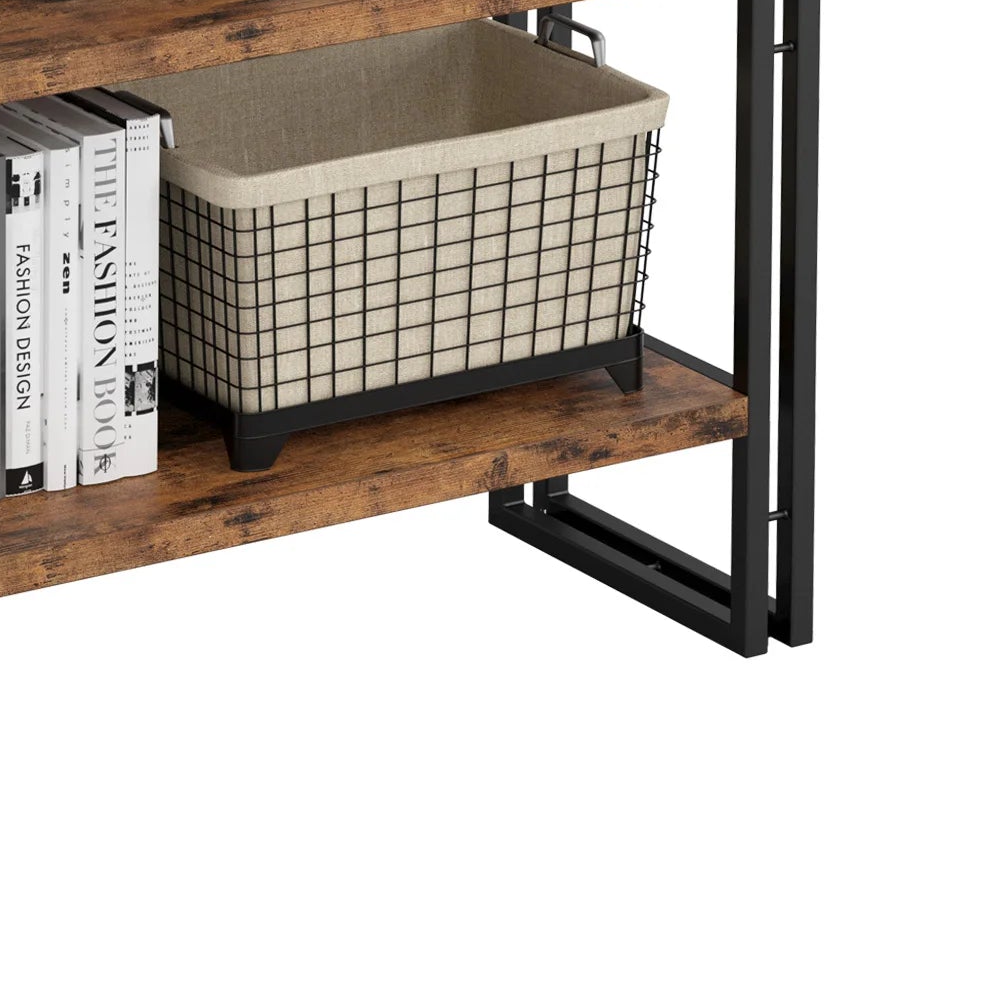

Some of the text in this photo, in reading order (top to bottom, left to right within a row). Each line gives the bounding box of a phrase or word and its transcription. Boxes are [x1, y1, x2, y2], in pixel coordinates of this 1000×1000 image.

[15, 244, 31, 331] FASHION
[62, 252, 71, 295] zen
[93, 138, 117, 475] THE FASHION BOOK
[16, 337, 31, 410] DESIGN
